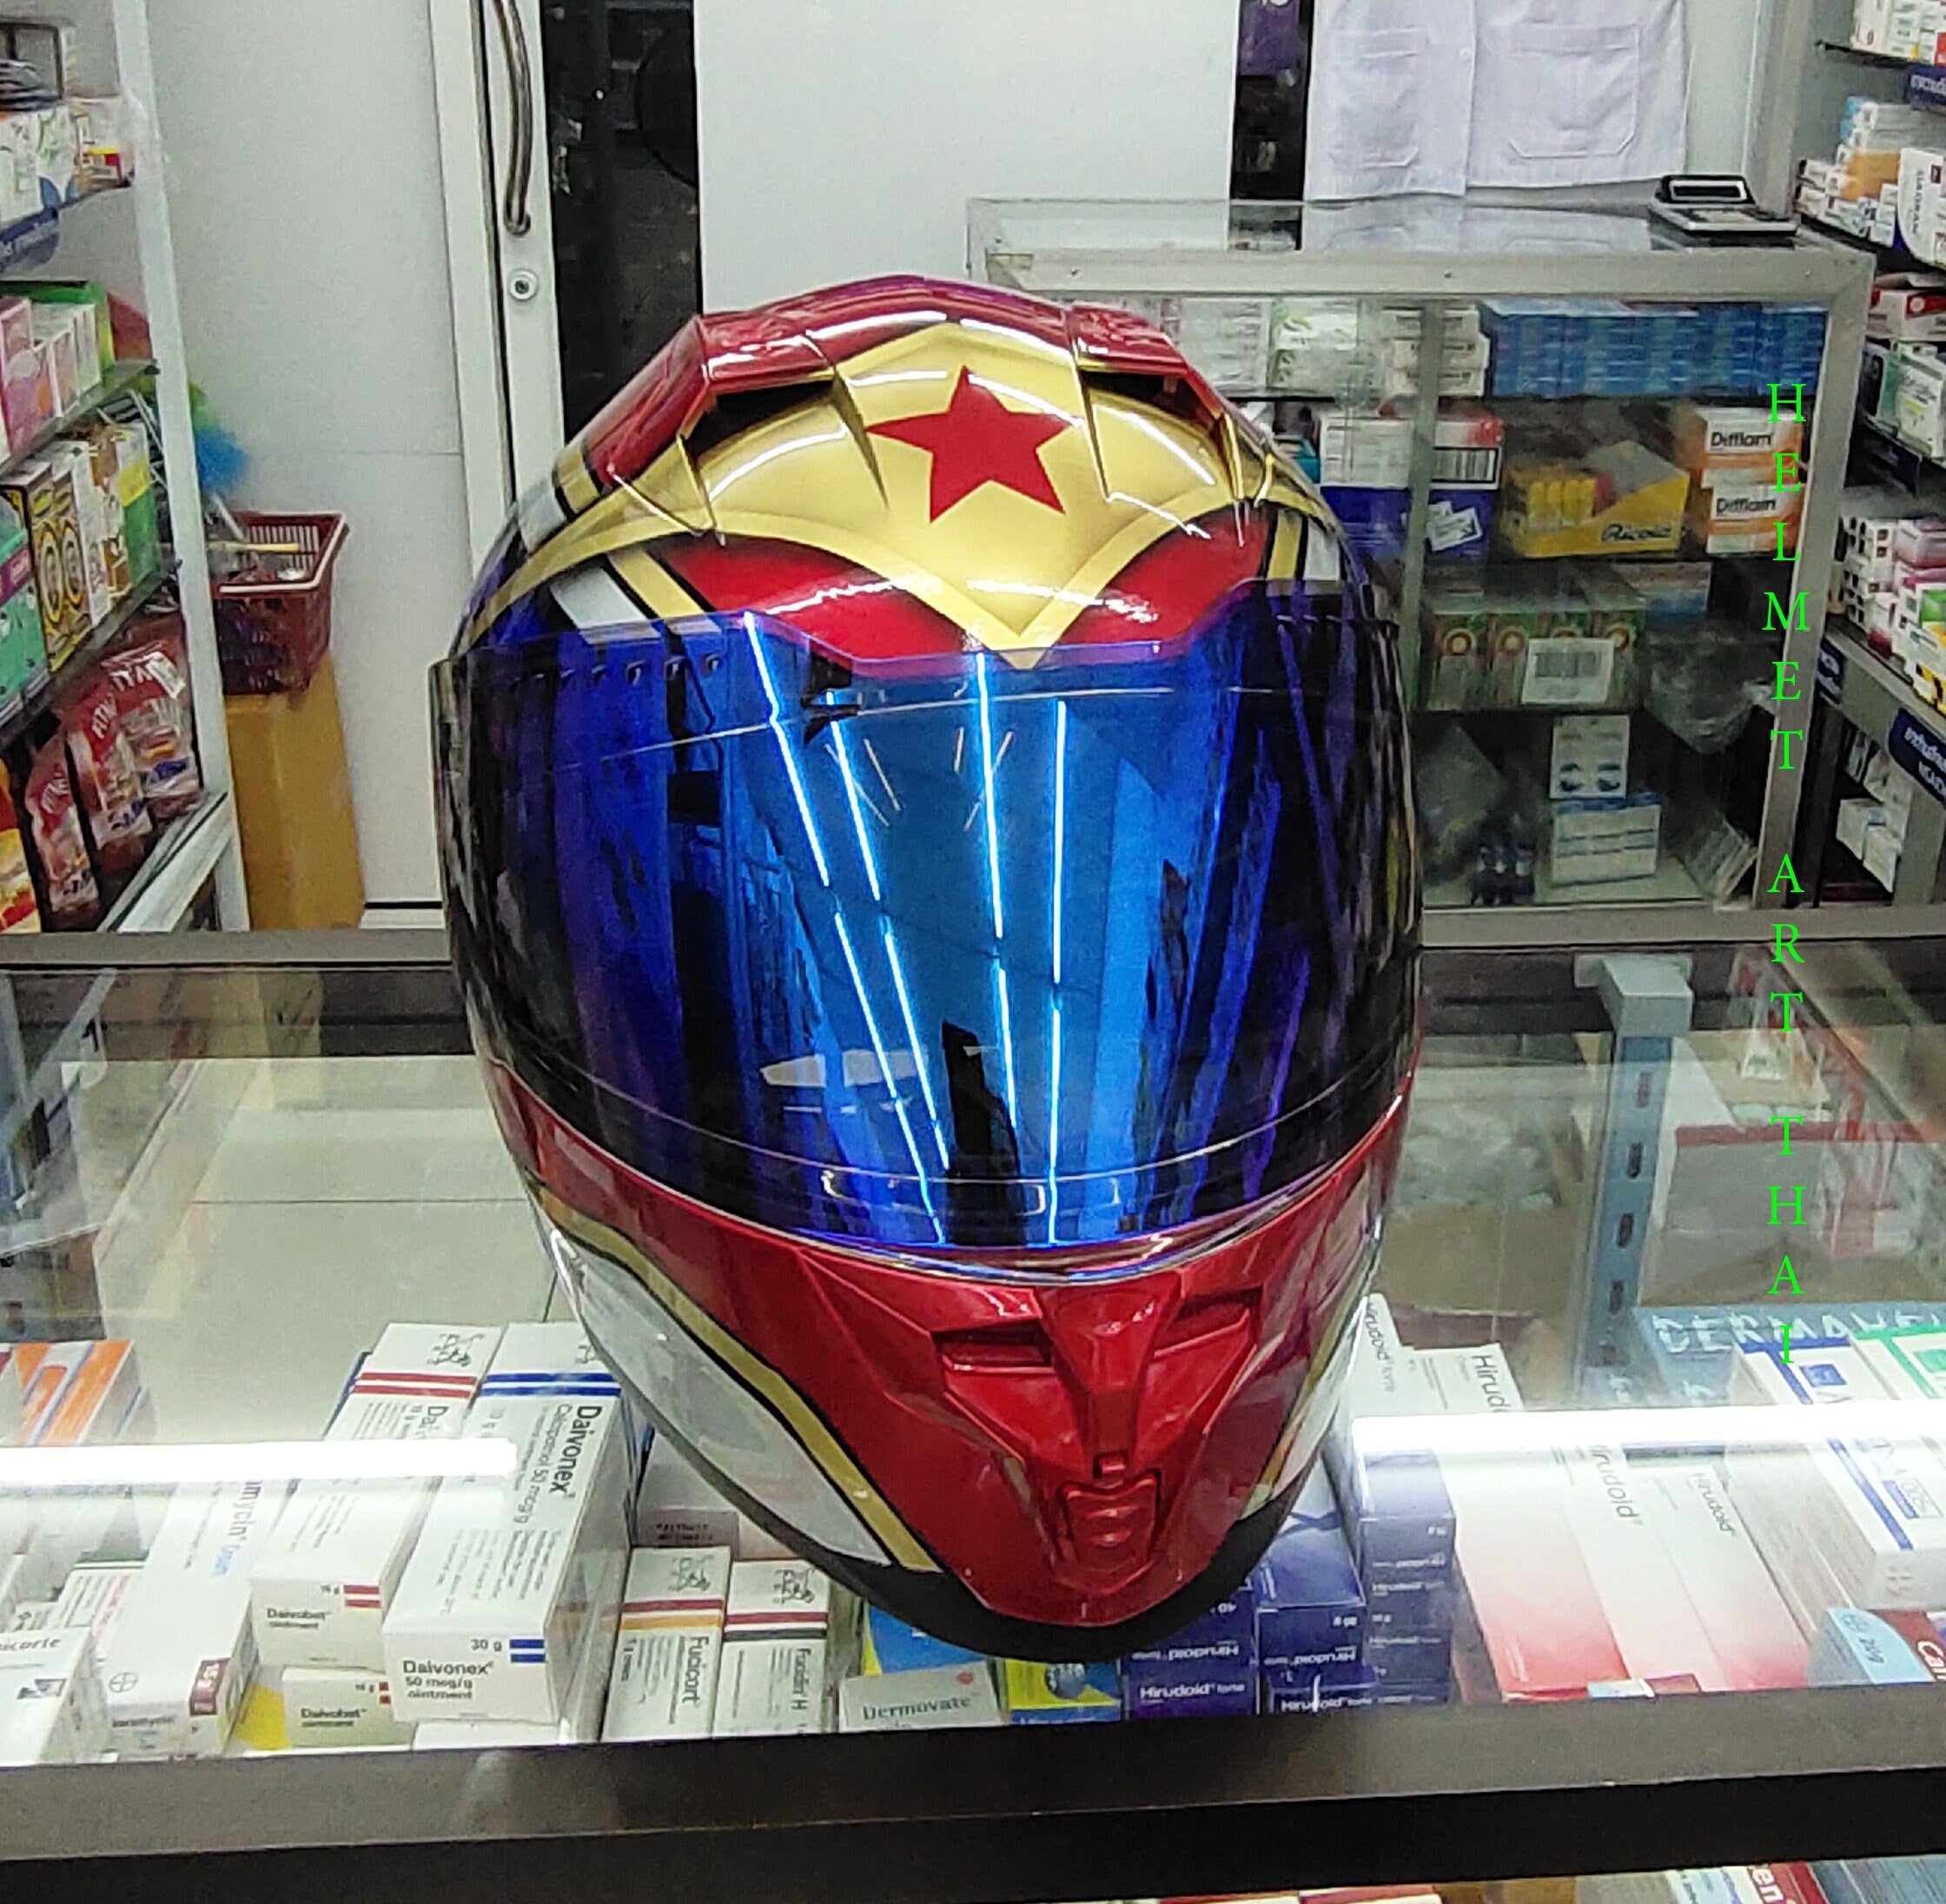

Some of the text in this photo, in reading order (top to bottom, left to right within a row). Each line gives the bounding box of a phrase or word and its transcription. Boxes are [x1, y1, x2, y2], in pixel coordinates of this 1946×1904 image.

[549, 1397, 603, 1494] Daivonex
[402, 1660, 488, 1676] Daivonex
[1140, 1683, 1214, 1699] Hirudoid
